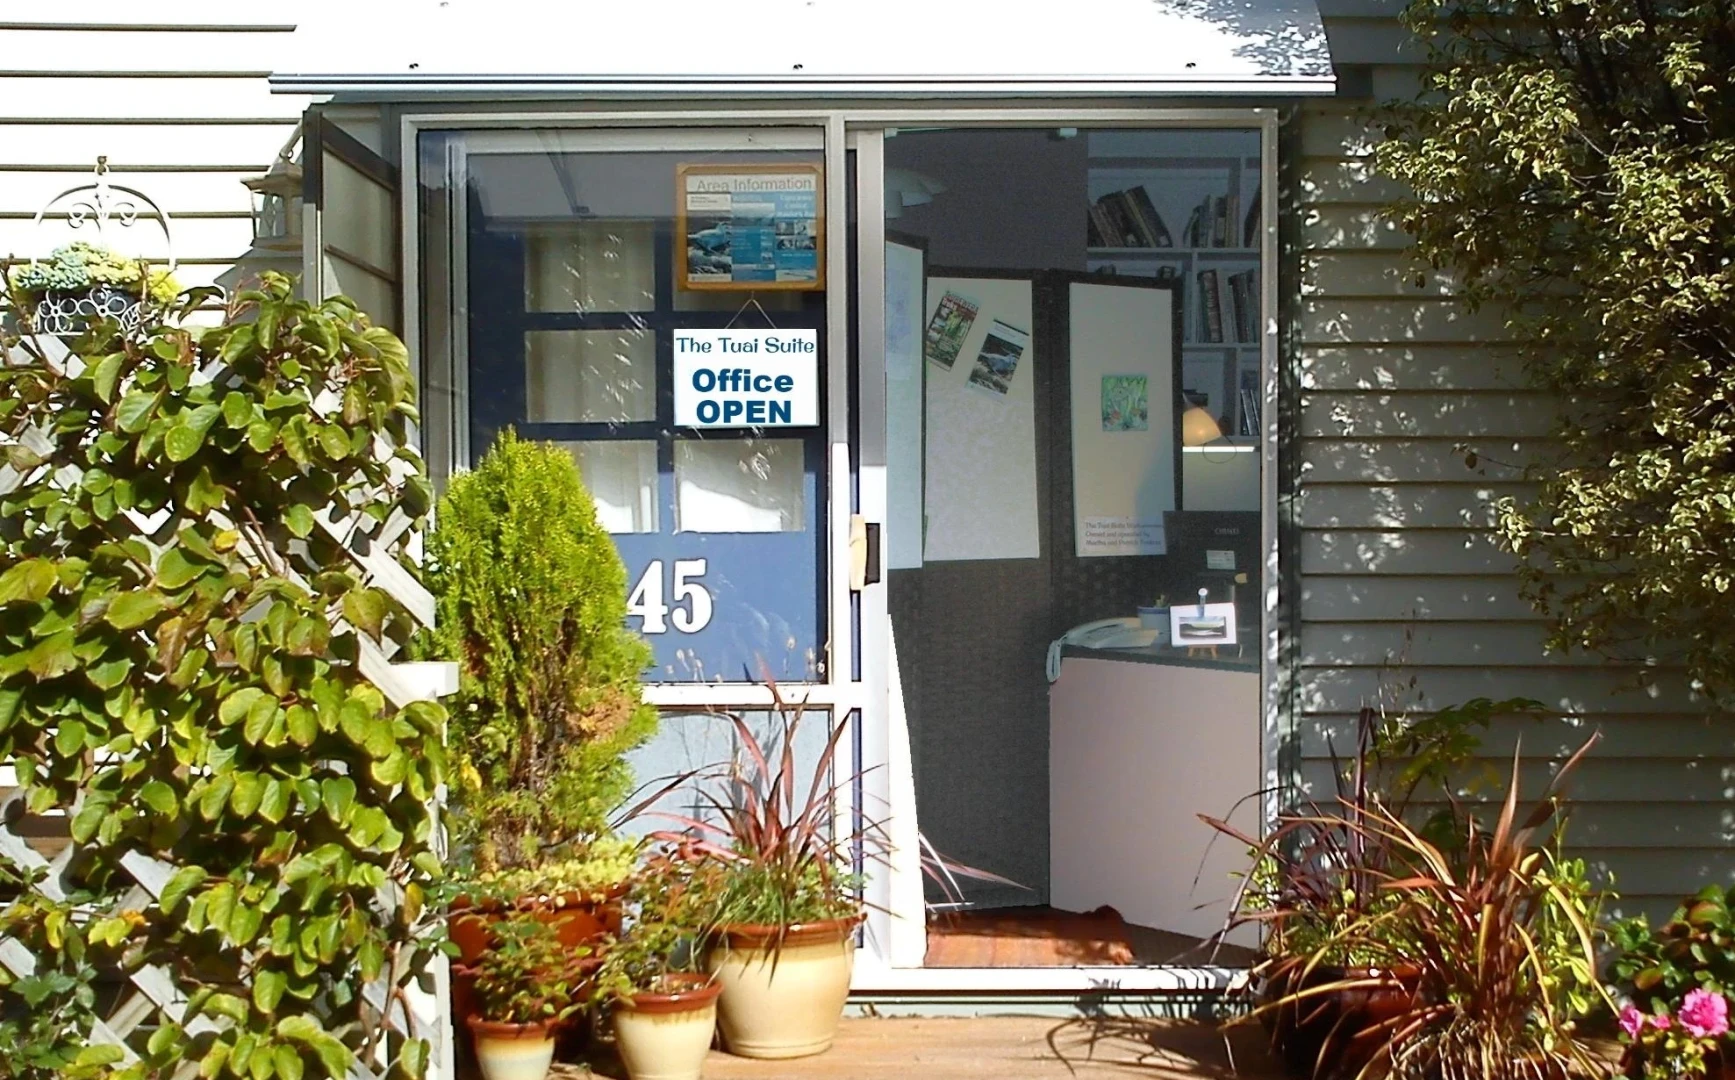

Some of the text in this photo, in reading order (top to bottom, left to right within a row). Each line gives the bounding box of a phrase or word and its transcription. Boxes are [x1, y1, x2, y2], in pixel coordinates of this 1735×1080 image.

[696, 177, 812, 191] Area Information
[676, 337, 815, 354] The Tuai Suite
[692, 368, 794, 392] Office
[696, 400, 791, 423] OPEN
[626, 558, 713, 634] 45
